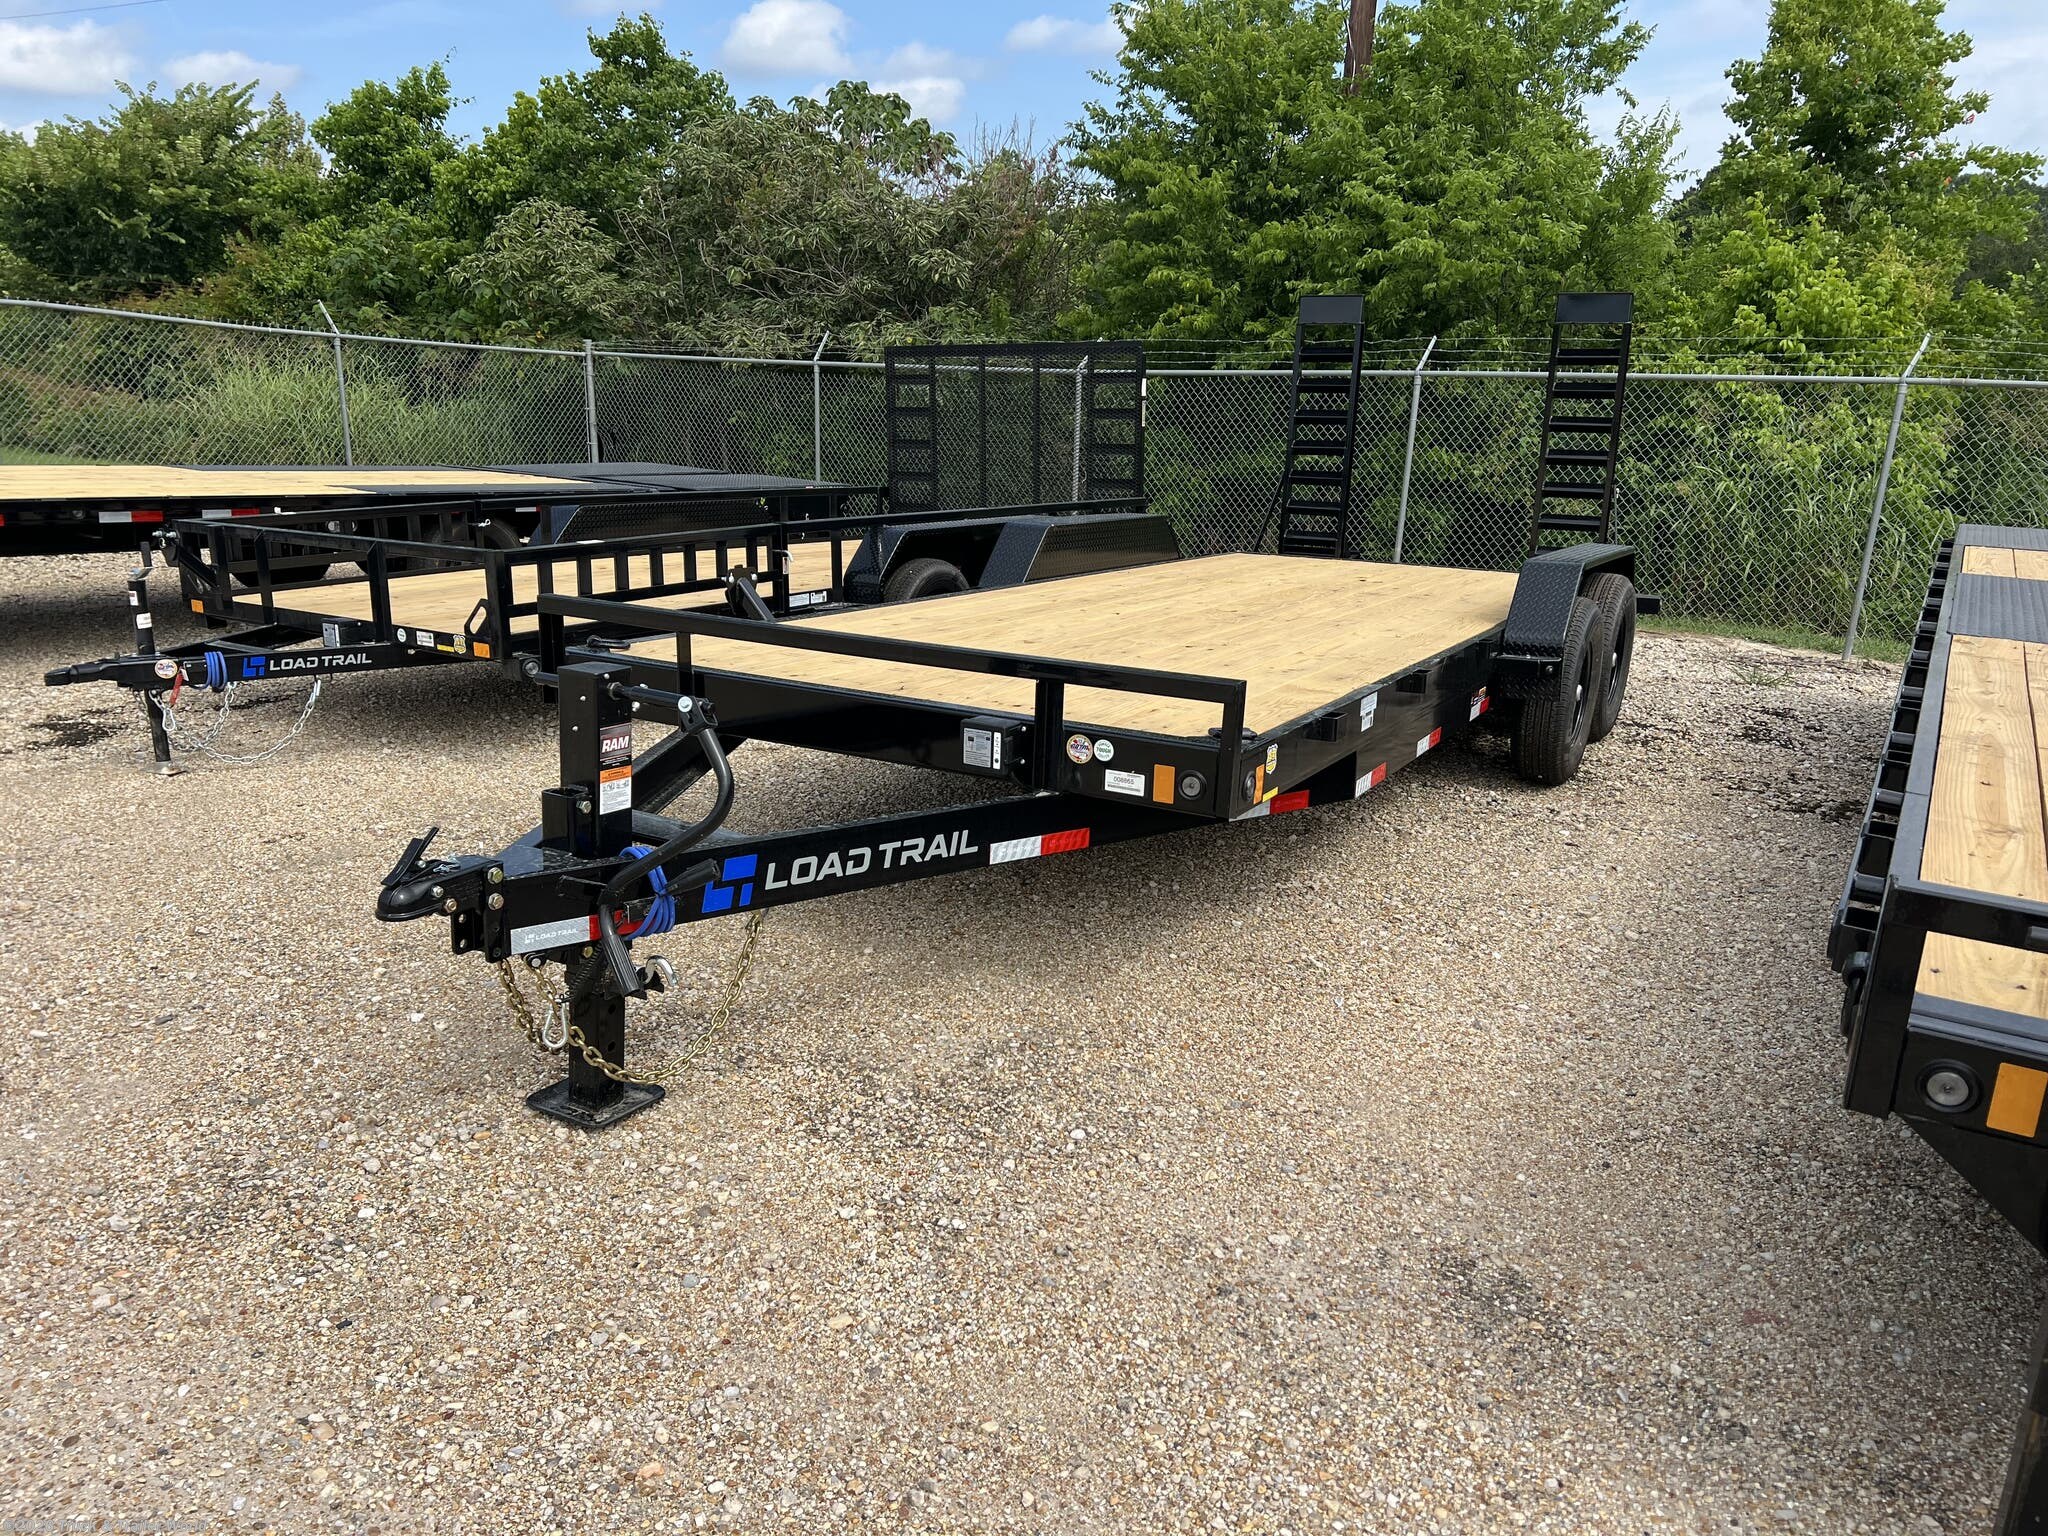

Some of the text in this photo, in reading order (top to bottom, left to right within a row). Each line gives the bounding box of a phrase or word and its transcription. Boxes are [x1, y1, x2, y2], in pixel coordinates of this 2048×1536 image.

[269, 657, 319, 671] LOAD
[321, 653, 372, 666] TRAIL
[601, 735, 630, 753] RAM
[765, 847, 872, 890] LOAD
[878, 829, 979, 869] TRAIL
[536, 931, 557, 940] LOAD
